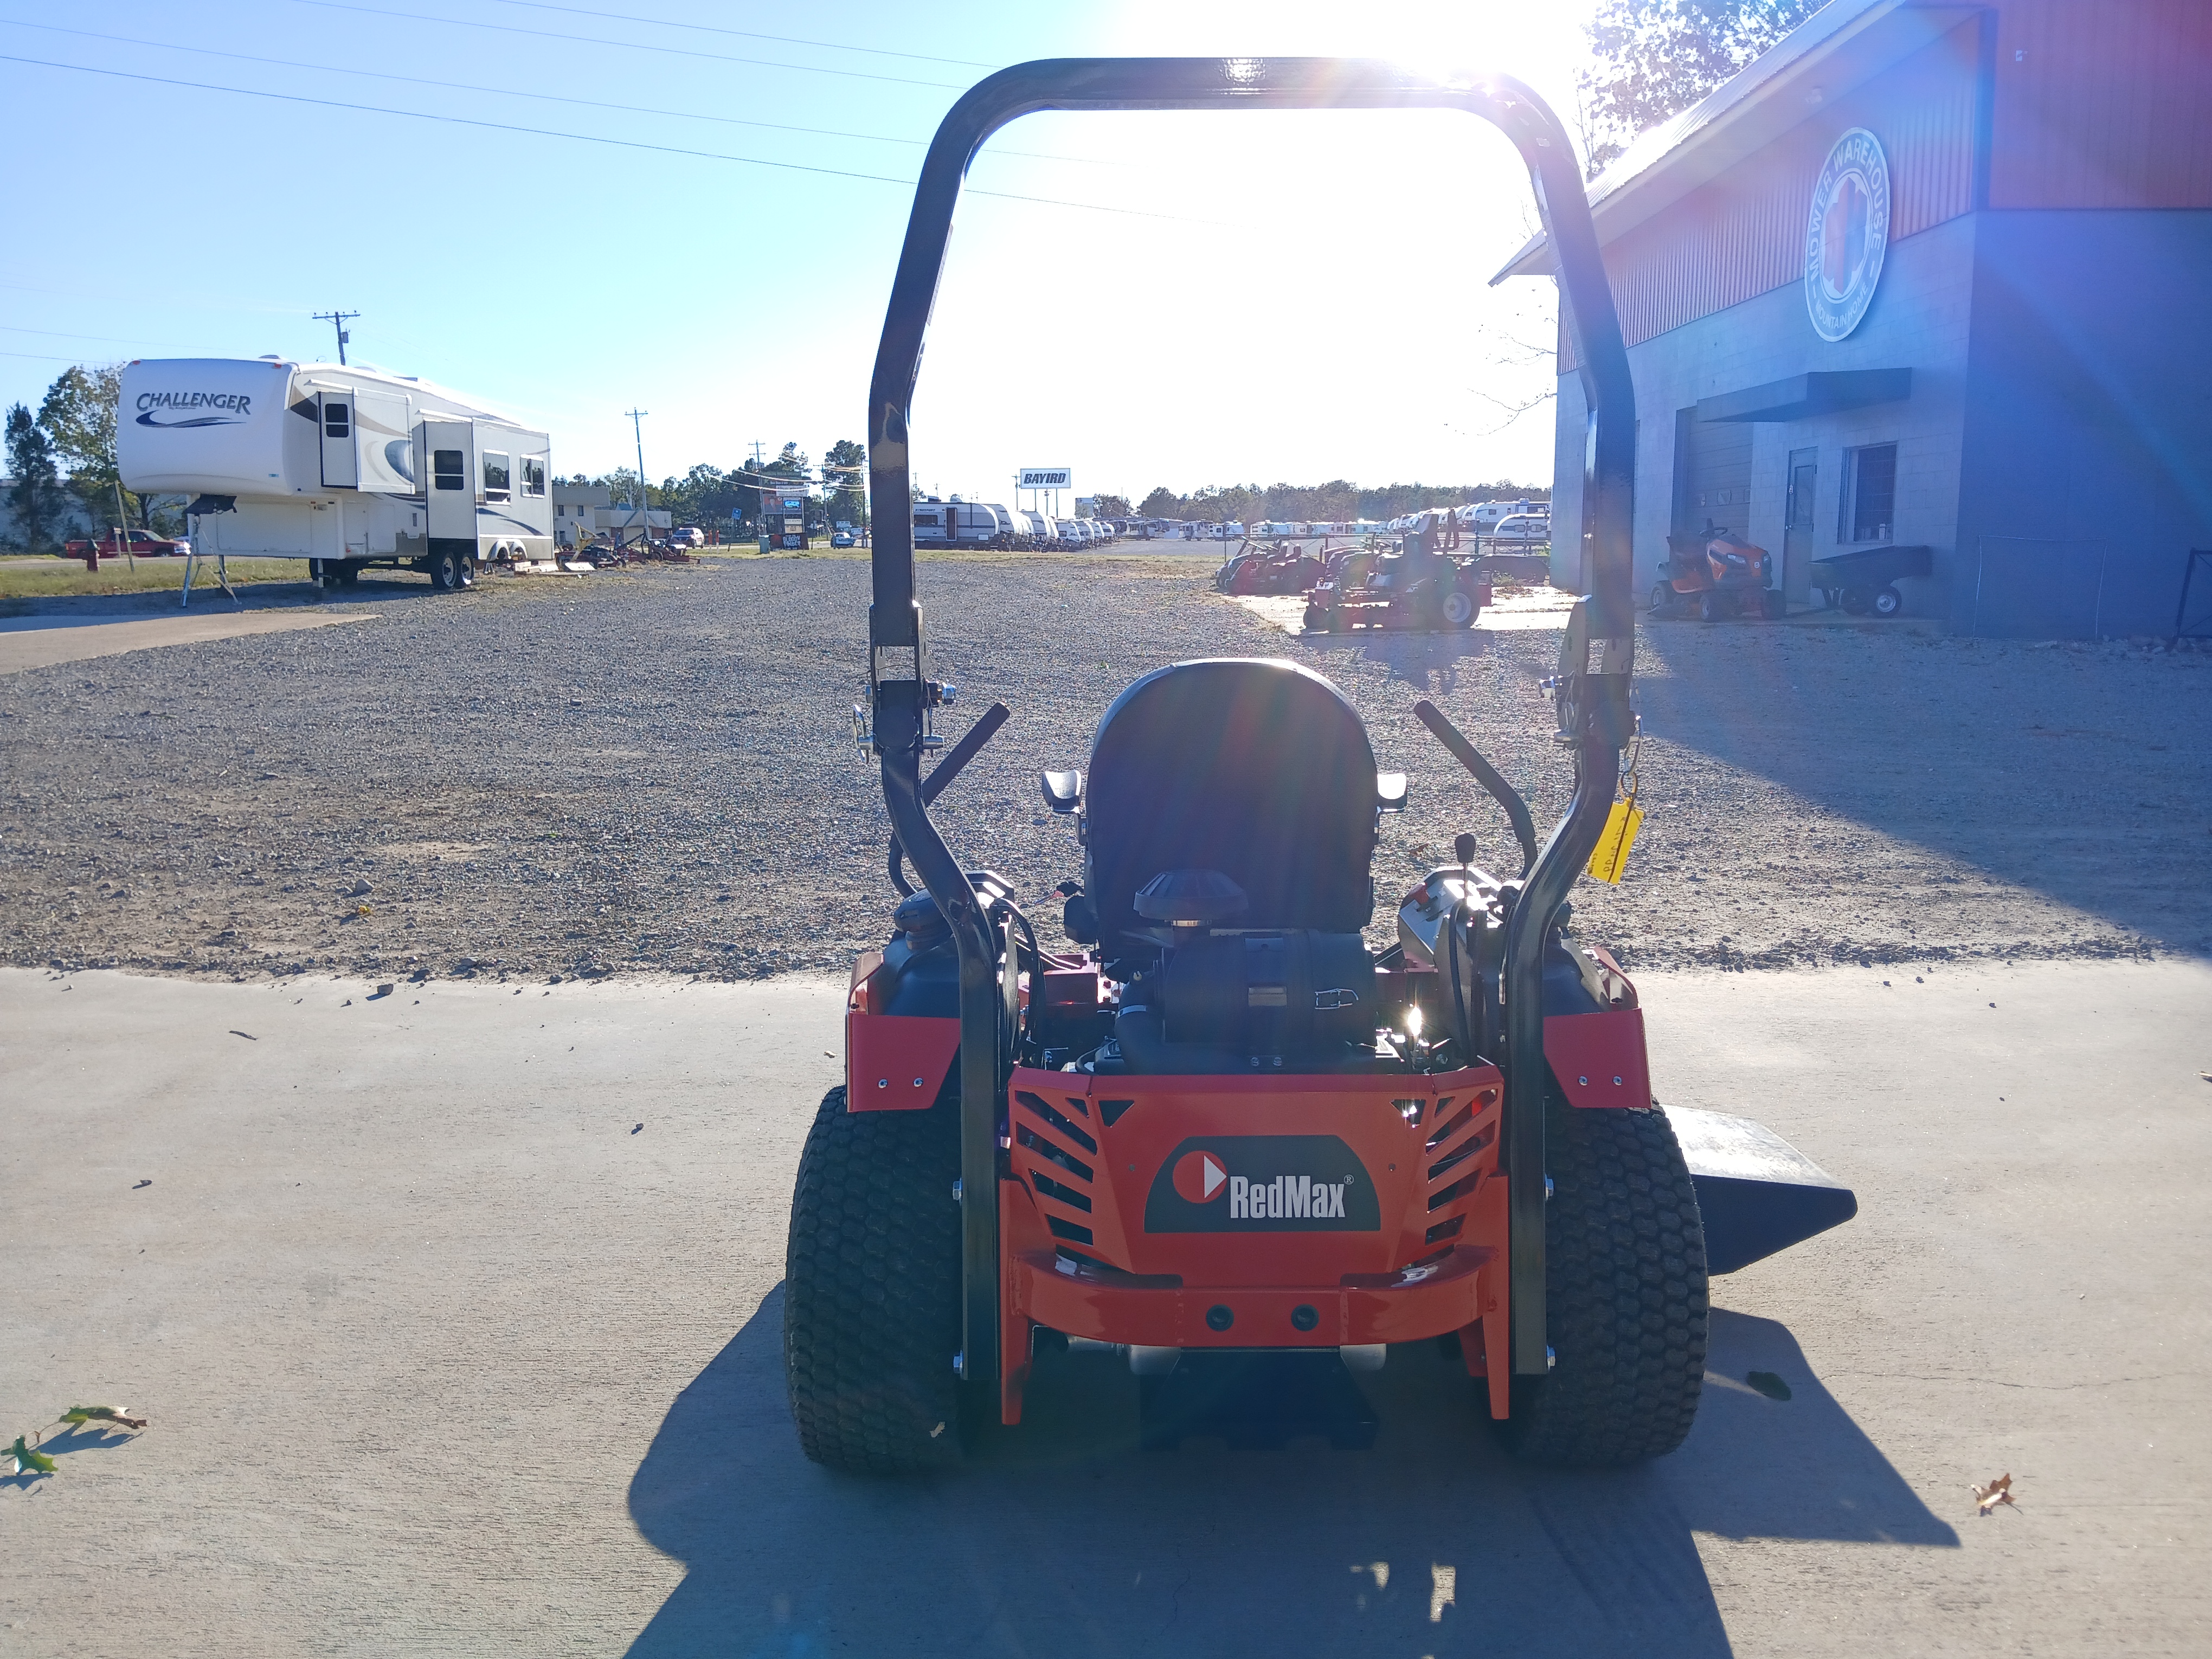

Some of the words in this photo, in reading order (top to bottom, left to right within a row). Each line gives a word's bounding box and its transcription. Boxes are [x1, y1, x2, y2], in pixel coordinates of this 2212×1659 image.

[1809, 170, 1832, 282] MOWER
[1833, 138, 1883, 250] WAREHOUSE
[1815, 299, 1847, 329] MOUNTAIN
[1848, 282, 1869, 321] HOME
[136, 392, 251, 415] CHALLENGER
[1023, 473, 1066, 484] BAYIRD
